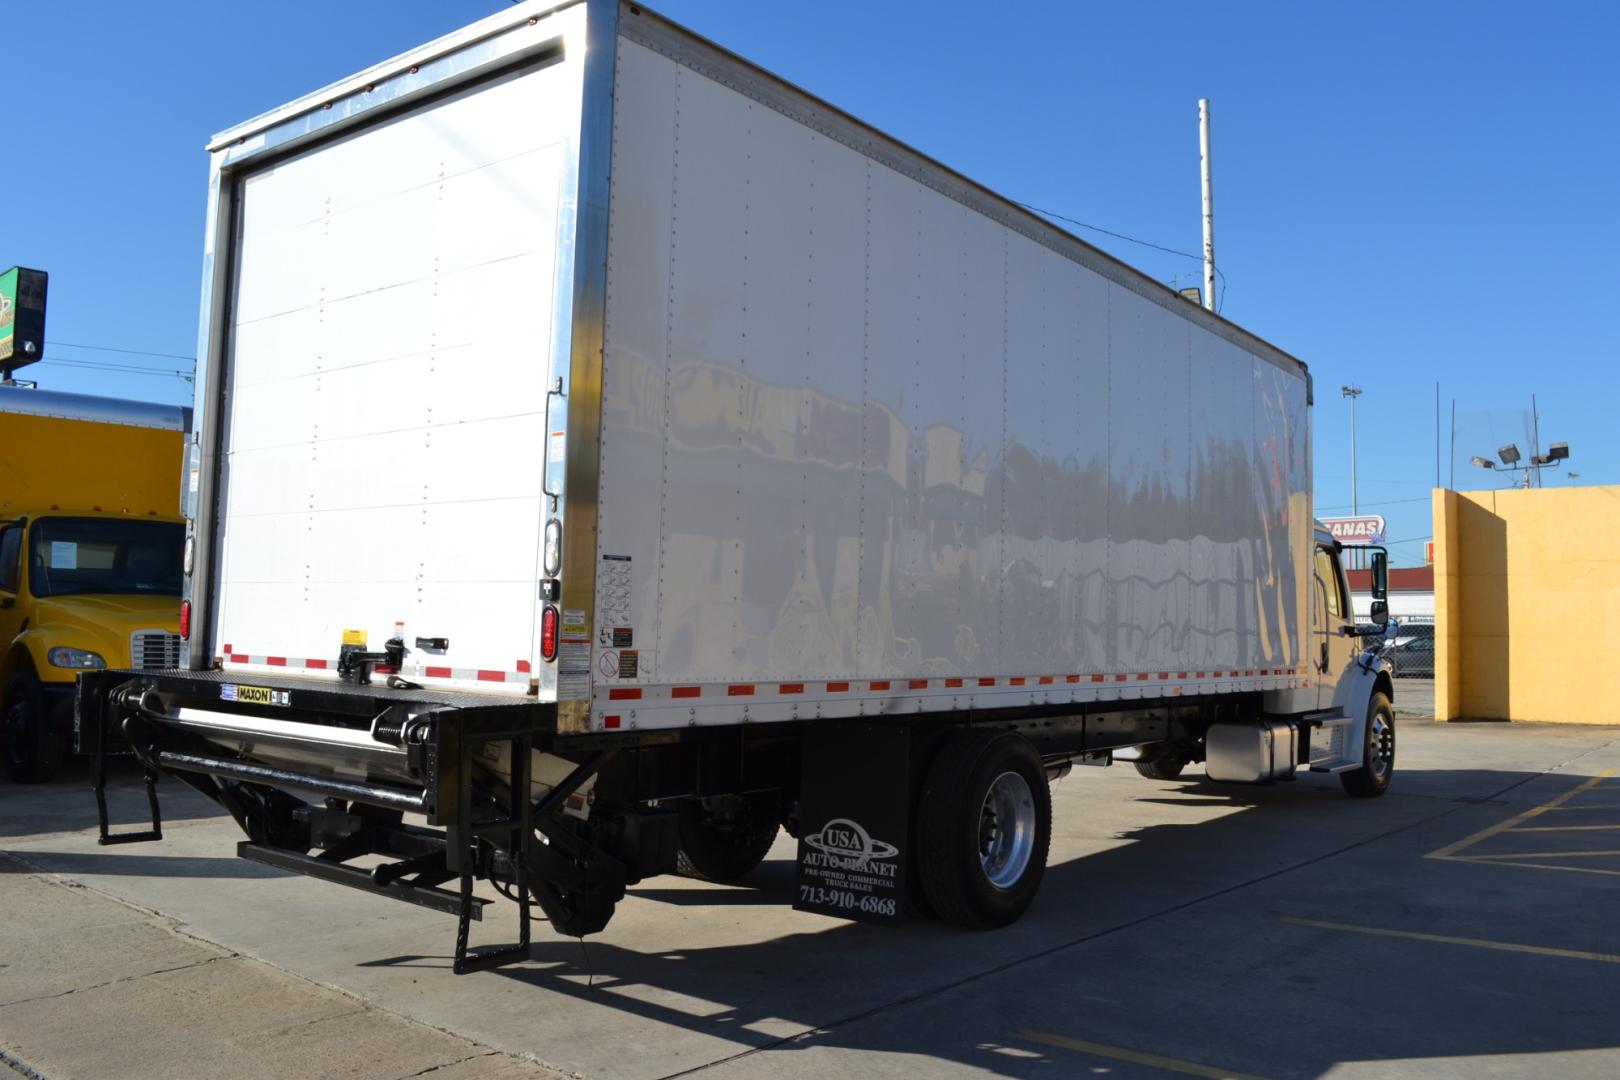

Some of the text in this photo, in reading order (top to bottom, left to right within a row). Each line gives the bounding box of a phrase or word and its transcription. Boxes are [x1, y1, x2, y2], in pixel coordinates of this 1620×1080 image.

[239, 687, 269, 702] MAXON
[827, 829, 862, 850] USA
[825, 878, 873, 892] TRUCK SALES
[847, 874, 895, 888] COMMERCIAL
[800, 884, 897, 916] 713-910-6868
